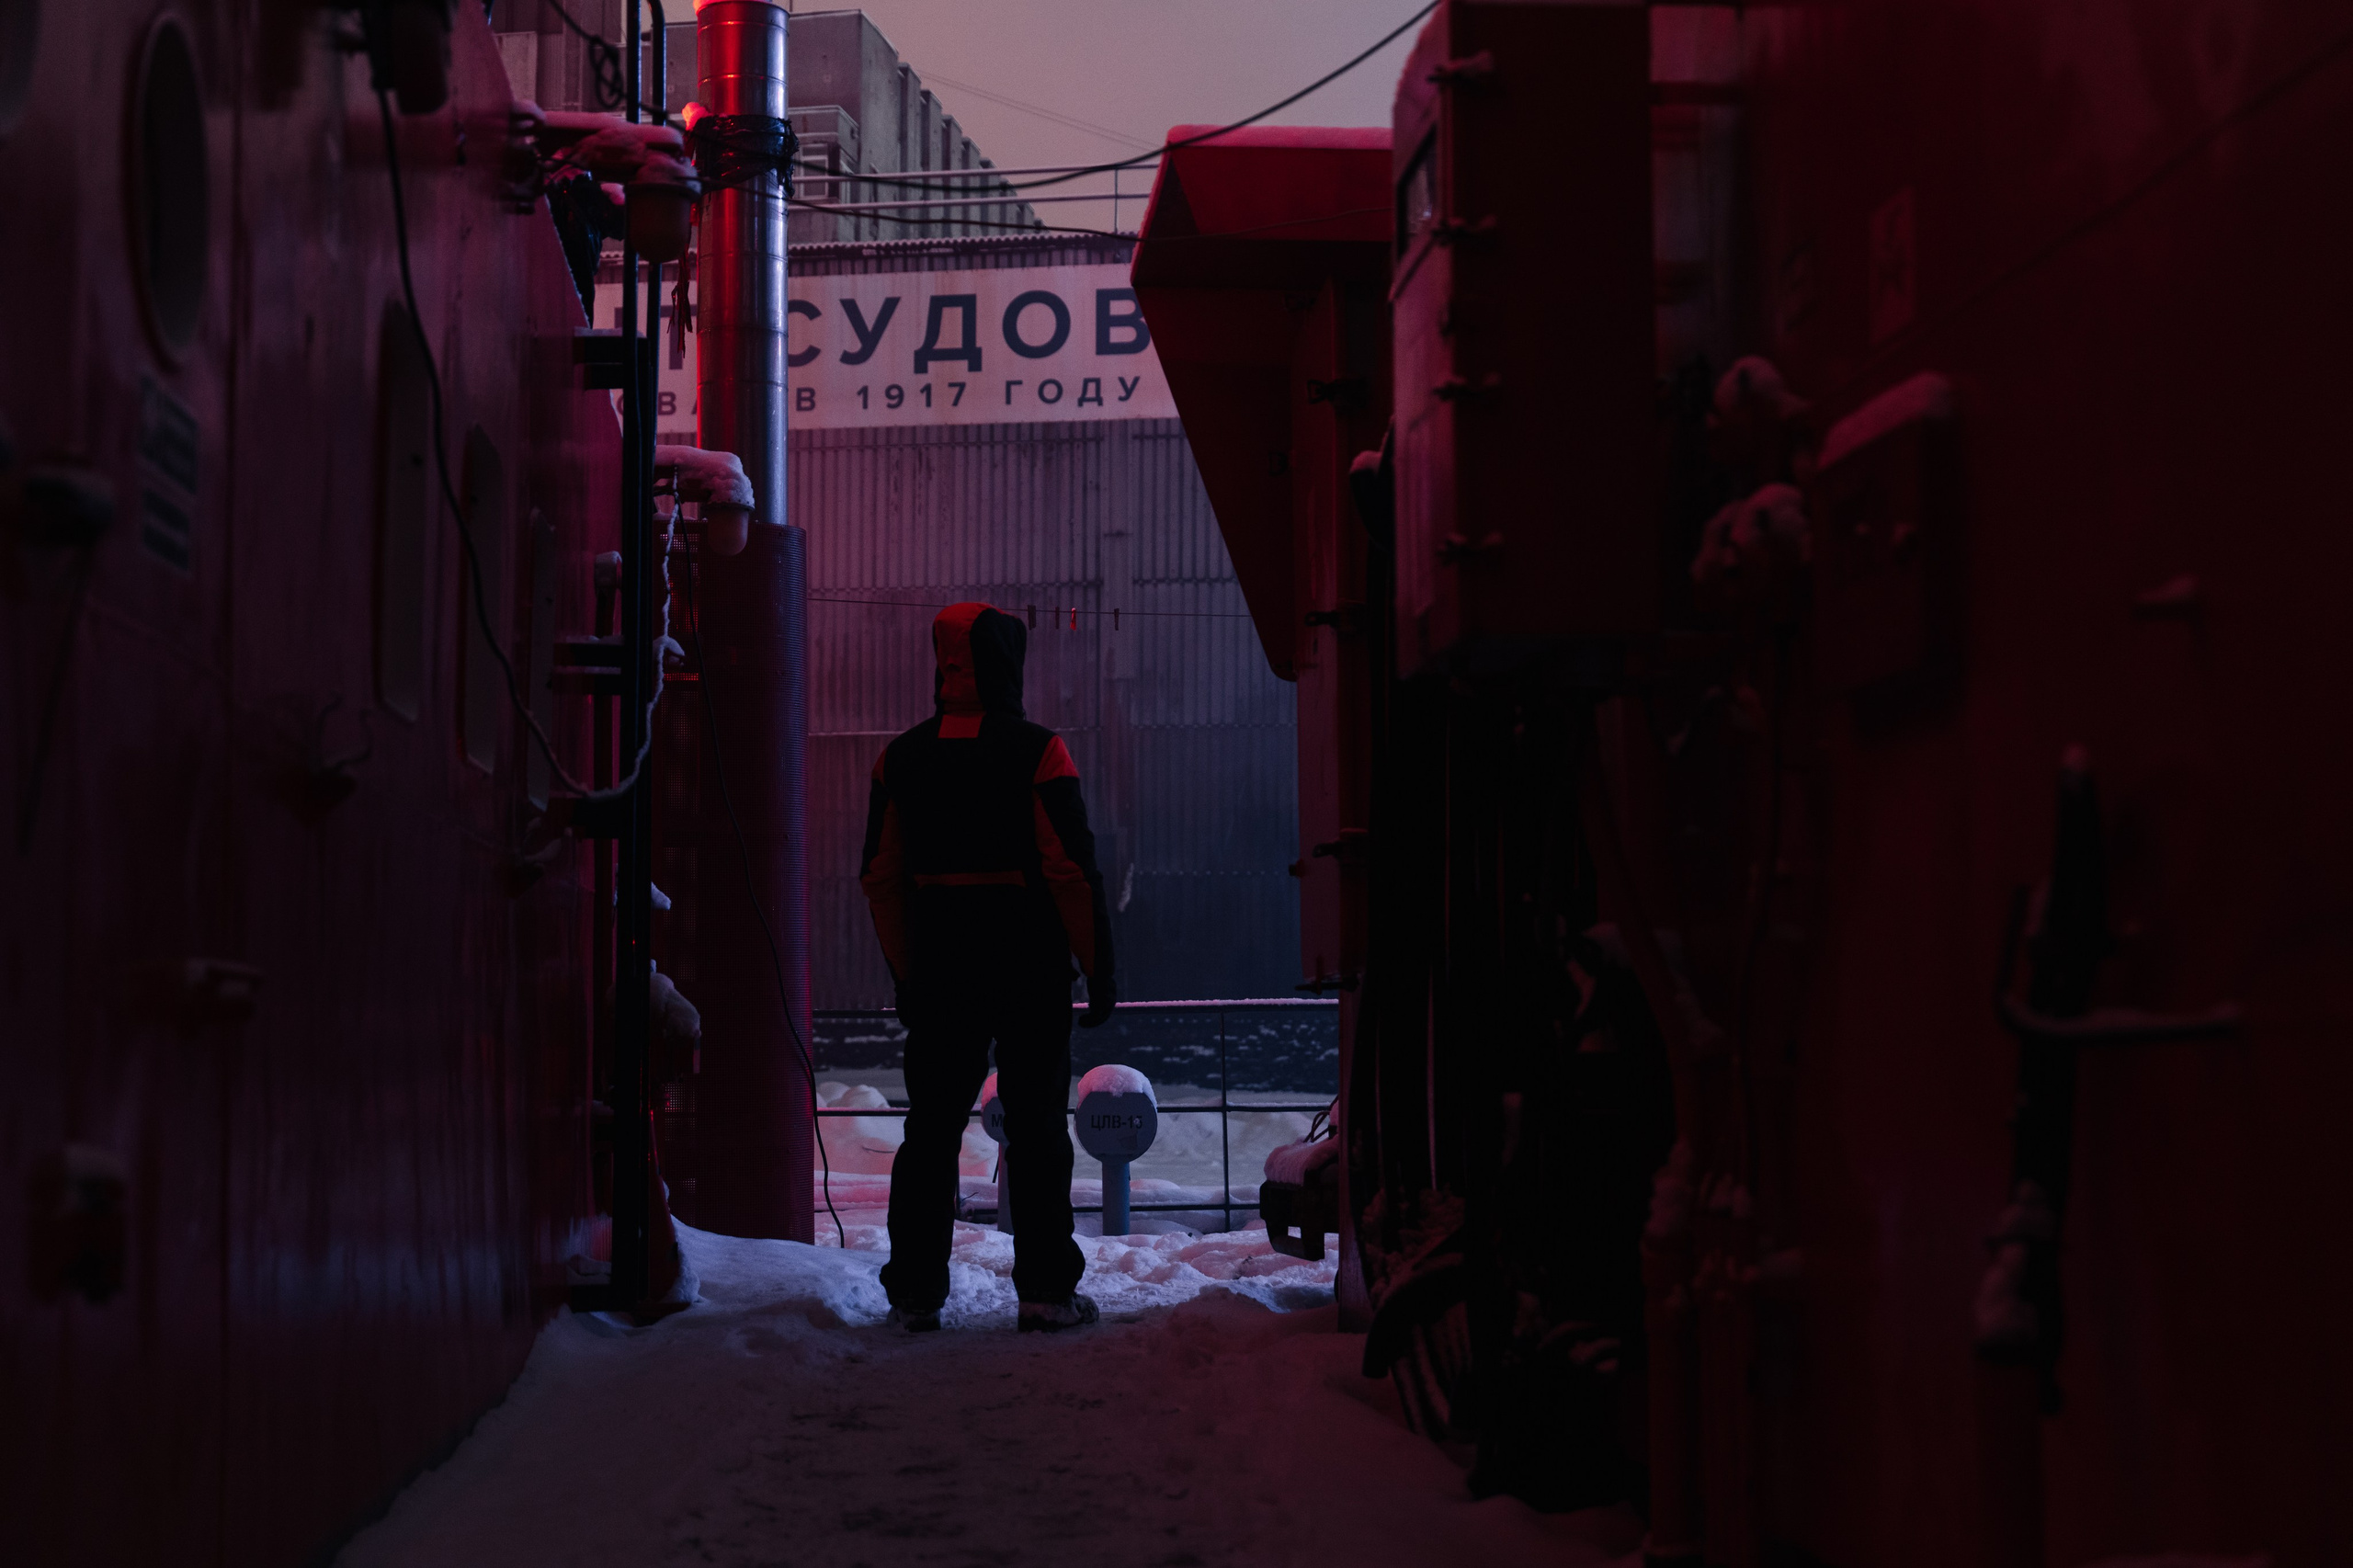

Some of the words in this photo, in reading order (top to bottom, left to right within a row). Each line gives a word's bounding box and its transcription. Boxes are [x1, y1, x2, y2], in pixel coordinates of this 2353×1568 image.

[796, 387, 816, 412] В
[857, 381, 966, 410] 1917
[1005, 376, 1141, 407] ГОДУ
